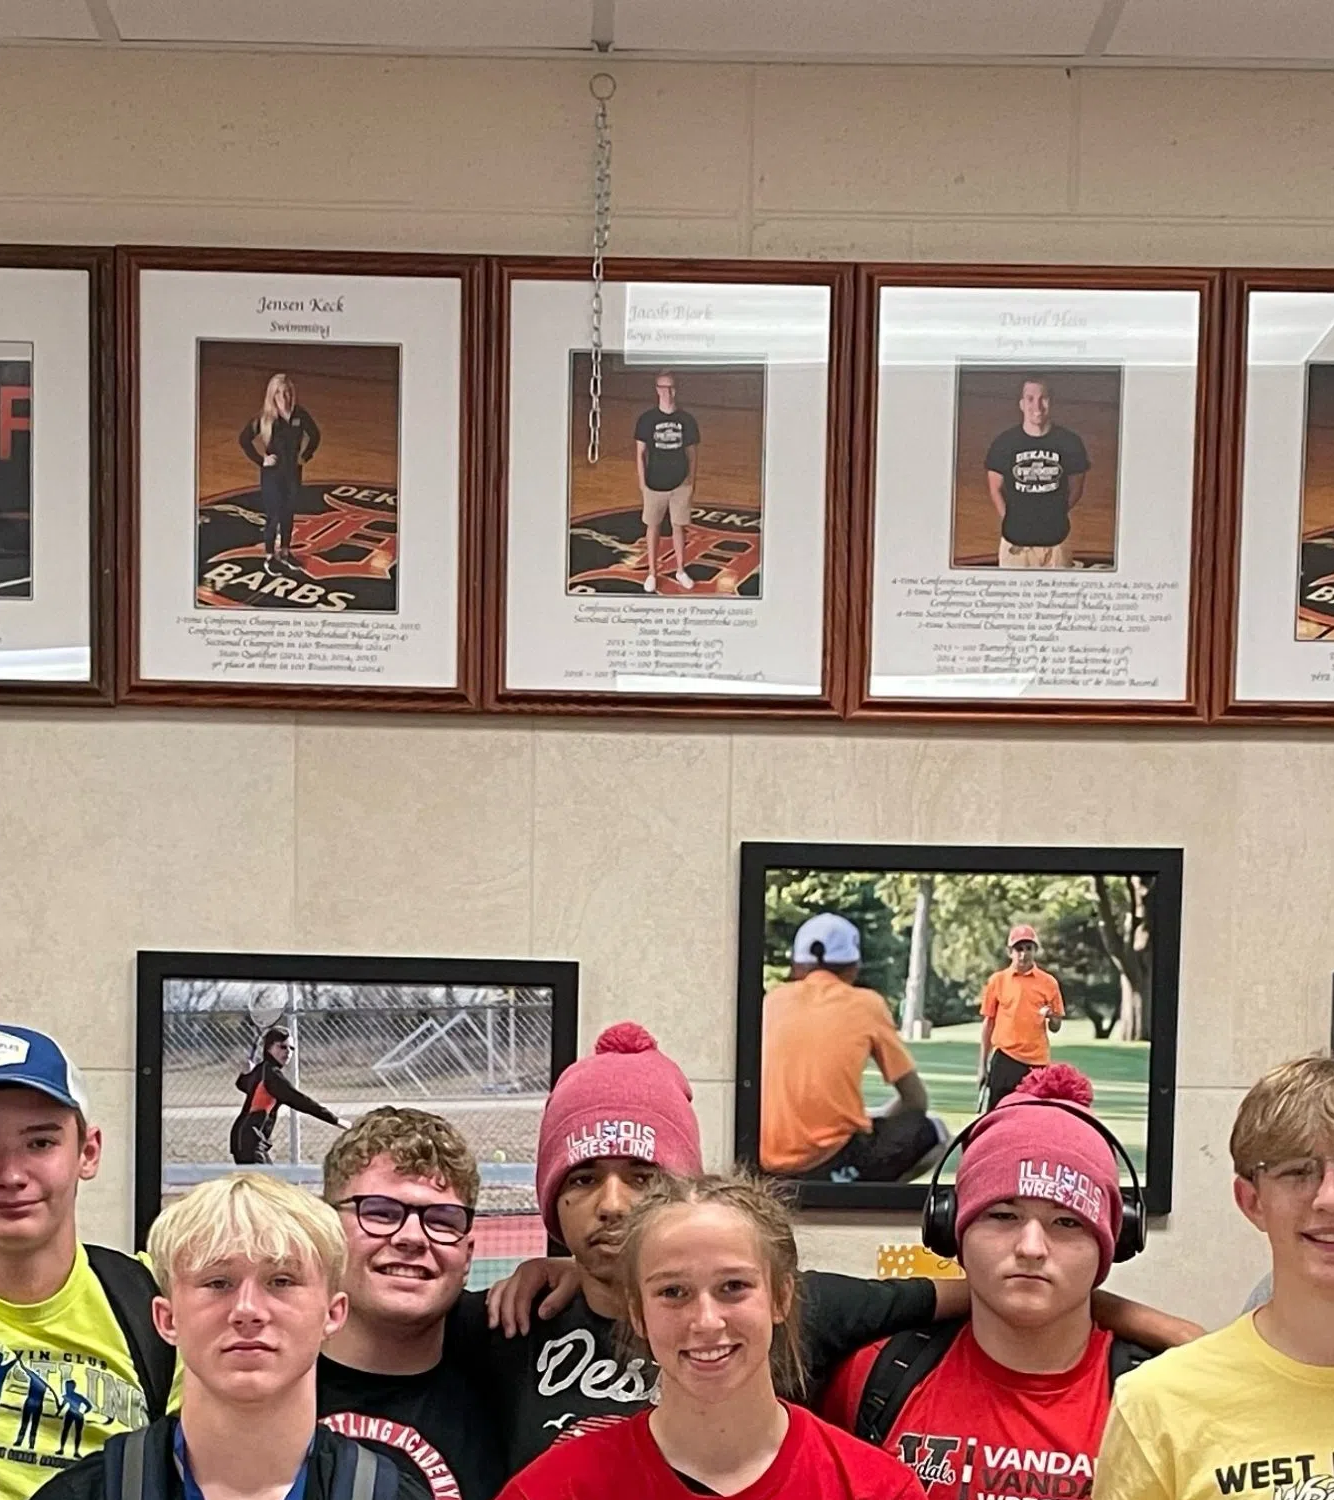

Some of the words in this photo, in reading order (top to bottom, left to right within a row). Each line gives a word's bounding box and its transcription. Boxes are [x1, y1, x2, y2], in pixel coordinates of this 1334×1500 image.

[255, 297, 305, 315] Jensen
[309, 296, 345, 314] Keck
[270, 320, 331, 338] Swimming
[204, 560, 356, 611] BARBS
[537, 1328, 661, 1406] Des
[324, 1412, 393, 1441] STLING
[393, 1427, 461, 1500] ACADEMY
[983, 1445, 1099, 1478] VANDA
[1215, 1454, 1315, 1495] WEST
[981, 1469, 1093, 1499] VANDA
